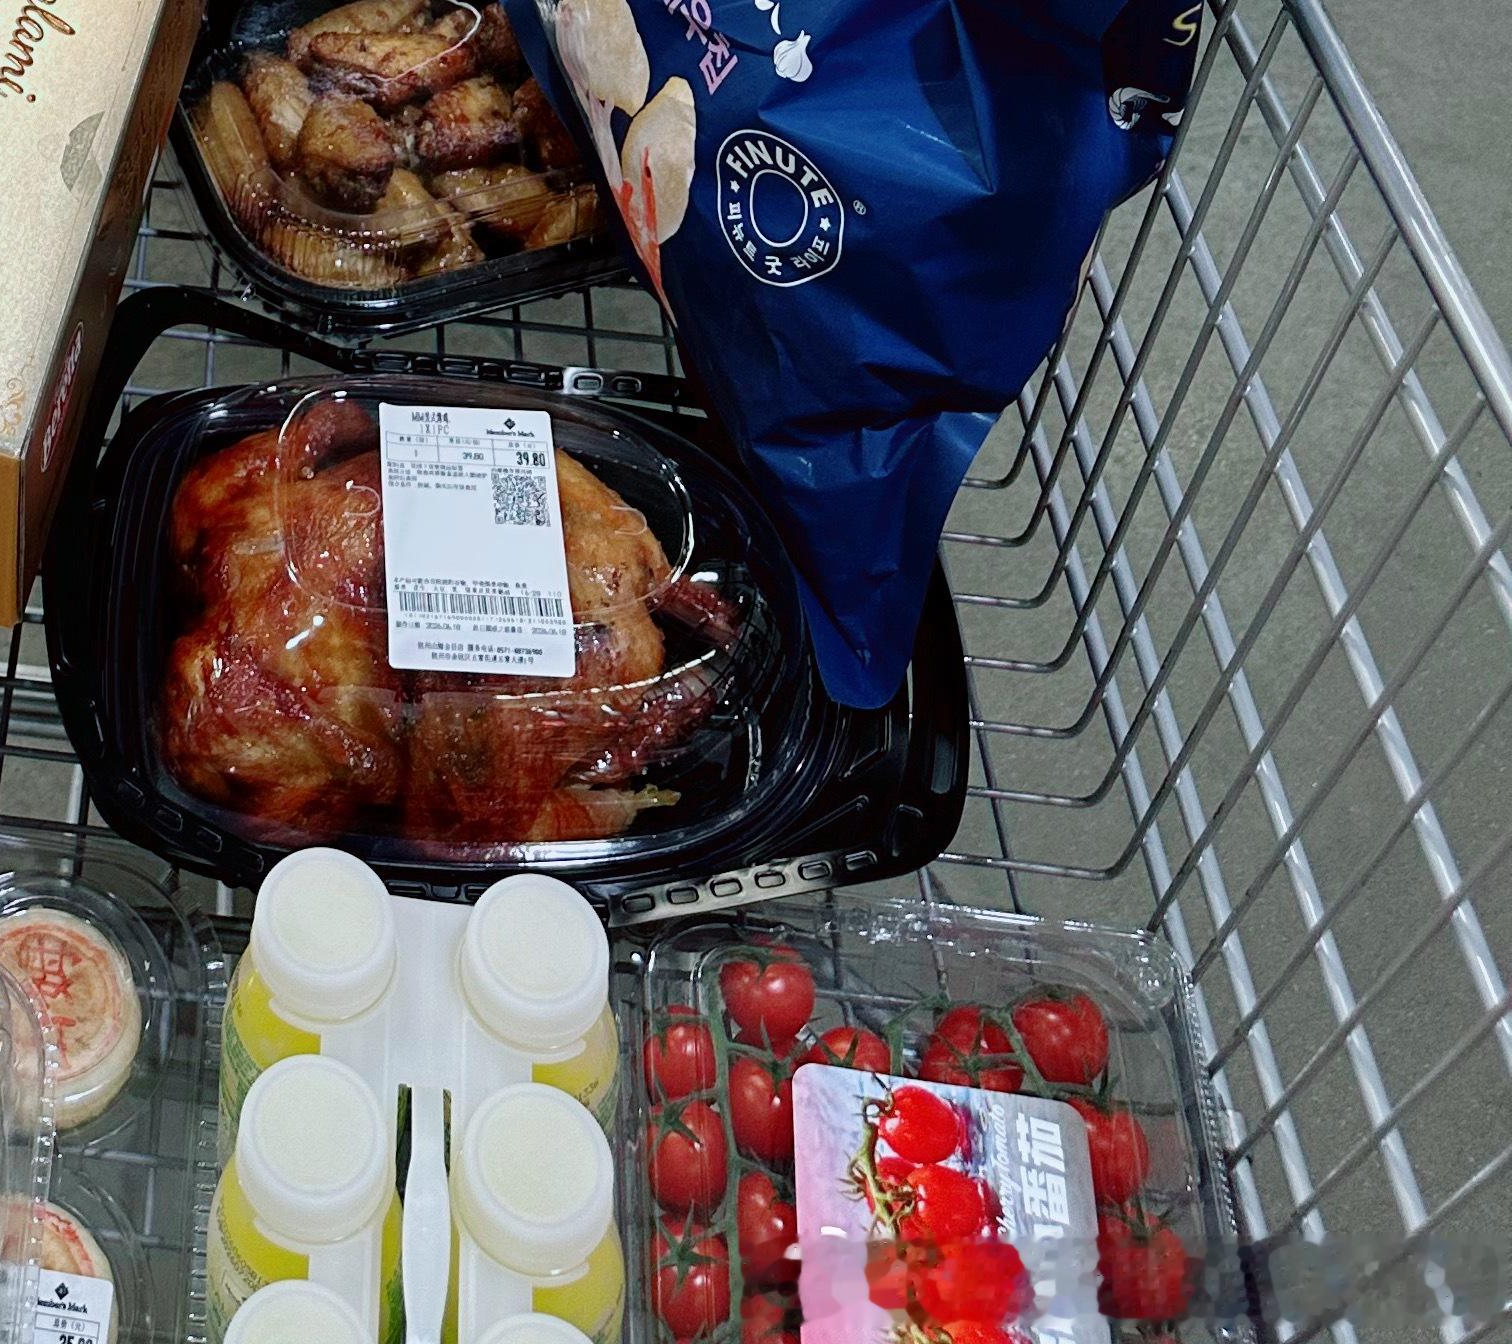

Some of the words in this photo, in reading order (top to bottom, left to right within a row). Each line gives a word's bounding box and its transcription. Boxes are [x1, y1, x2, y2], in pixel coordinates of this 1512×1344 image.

[726, 140, 834, 209] FINUTE
[516, 451, 546, 467] 39.80
[38, 1297, 67, 1310] ember's
